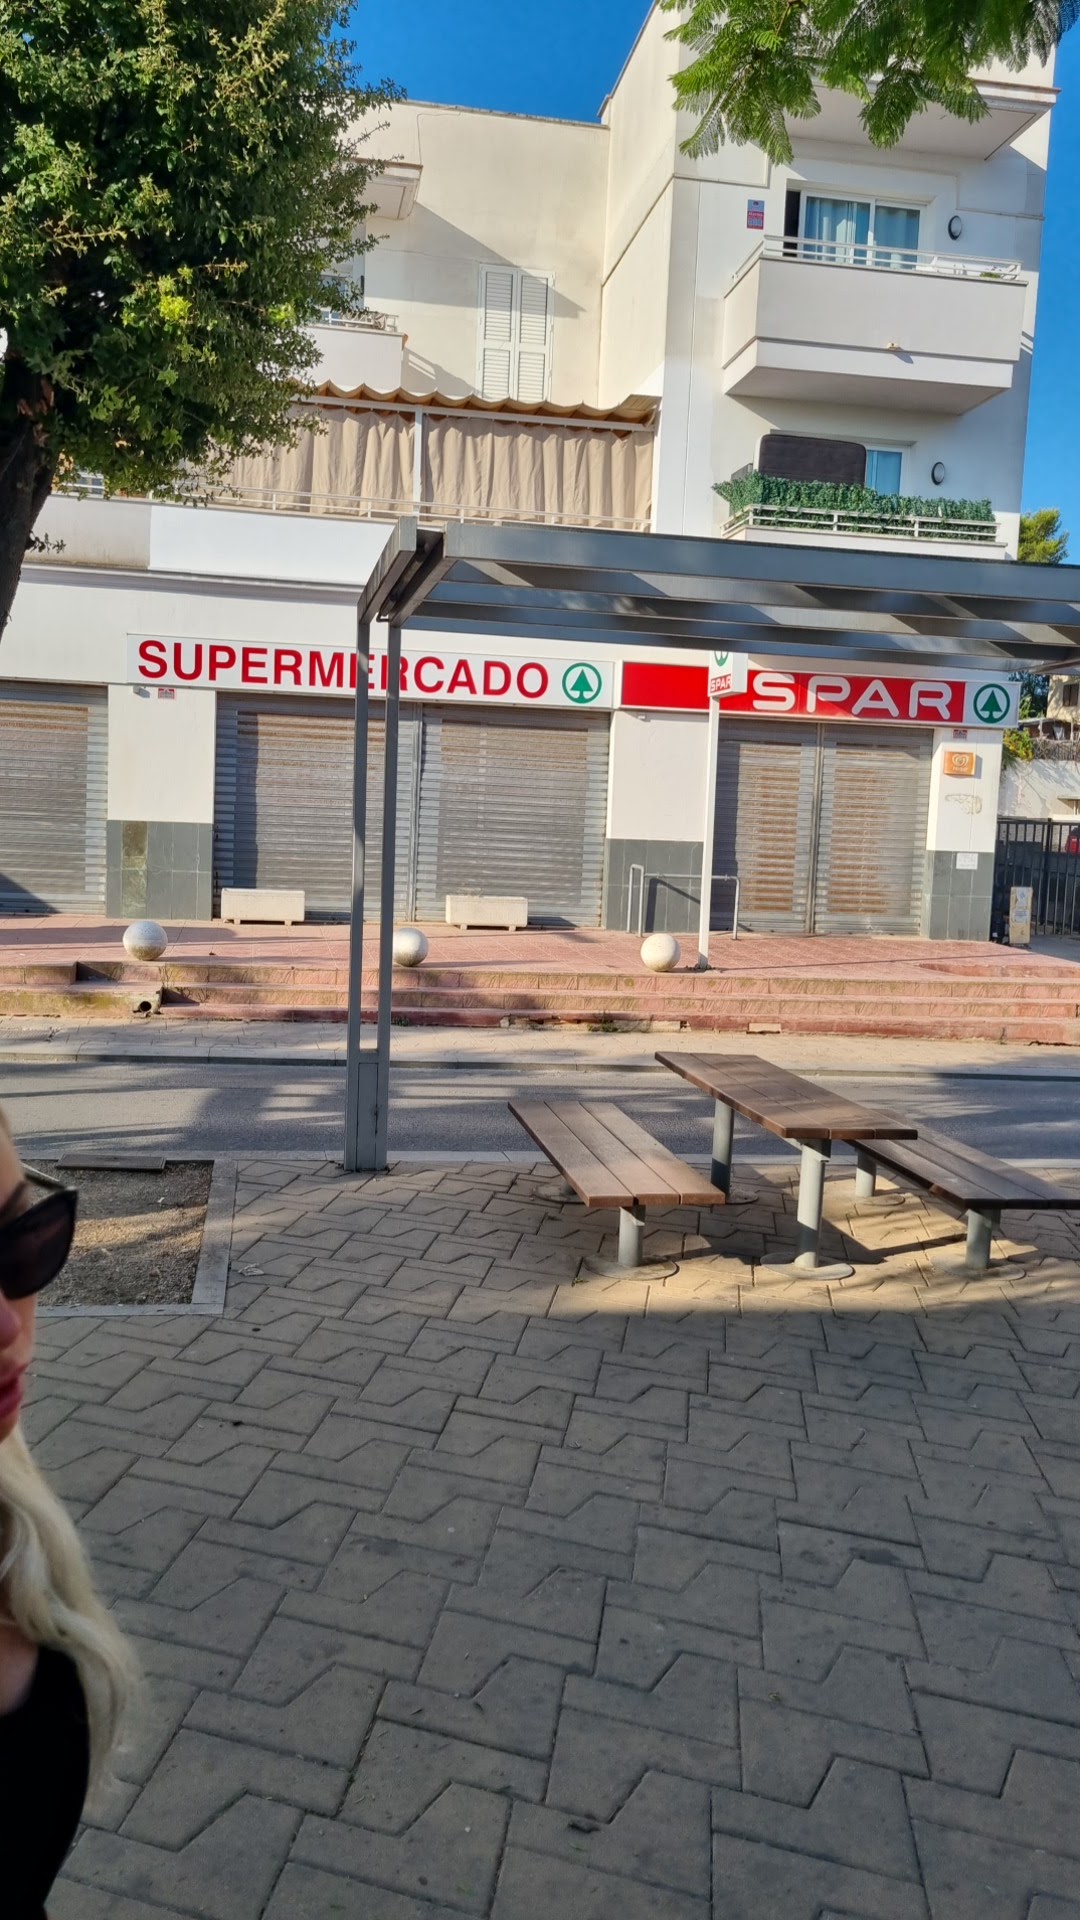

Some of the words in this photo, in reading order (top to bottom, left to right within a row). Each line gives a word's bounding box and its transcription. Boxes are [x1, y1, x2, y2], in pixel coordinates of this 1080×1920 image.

[137, 640, 549, 699] SUPERMERCADO
[711, 675, 731, 692] SPAR
[752, 672, 952, 720] SPAR
